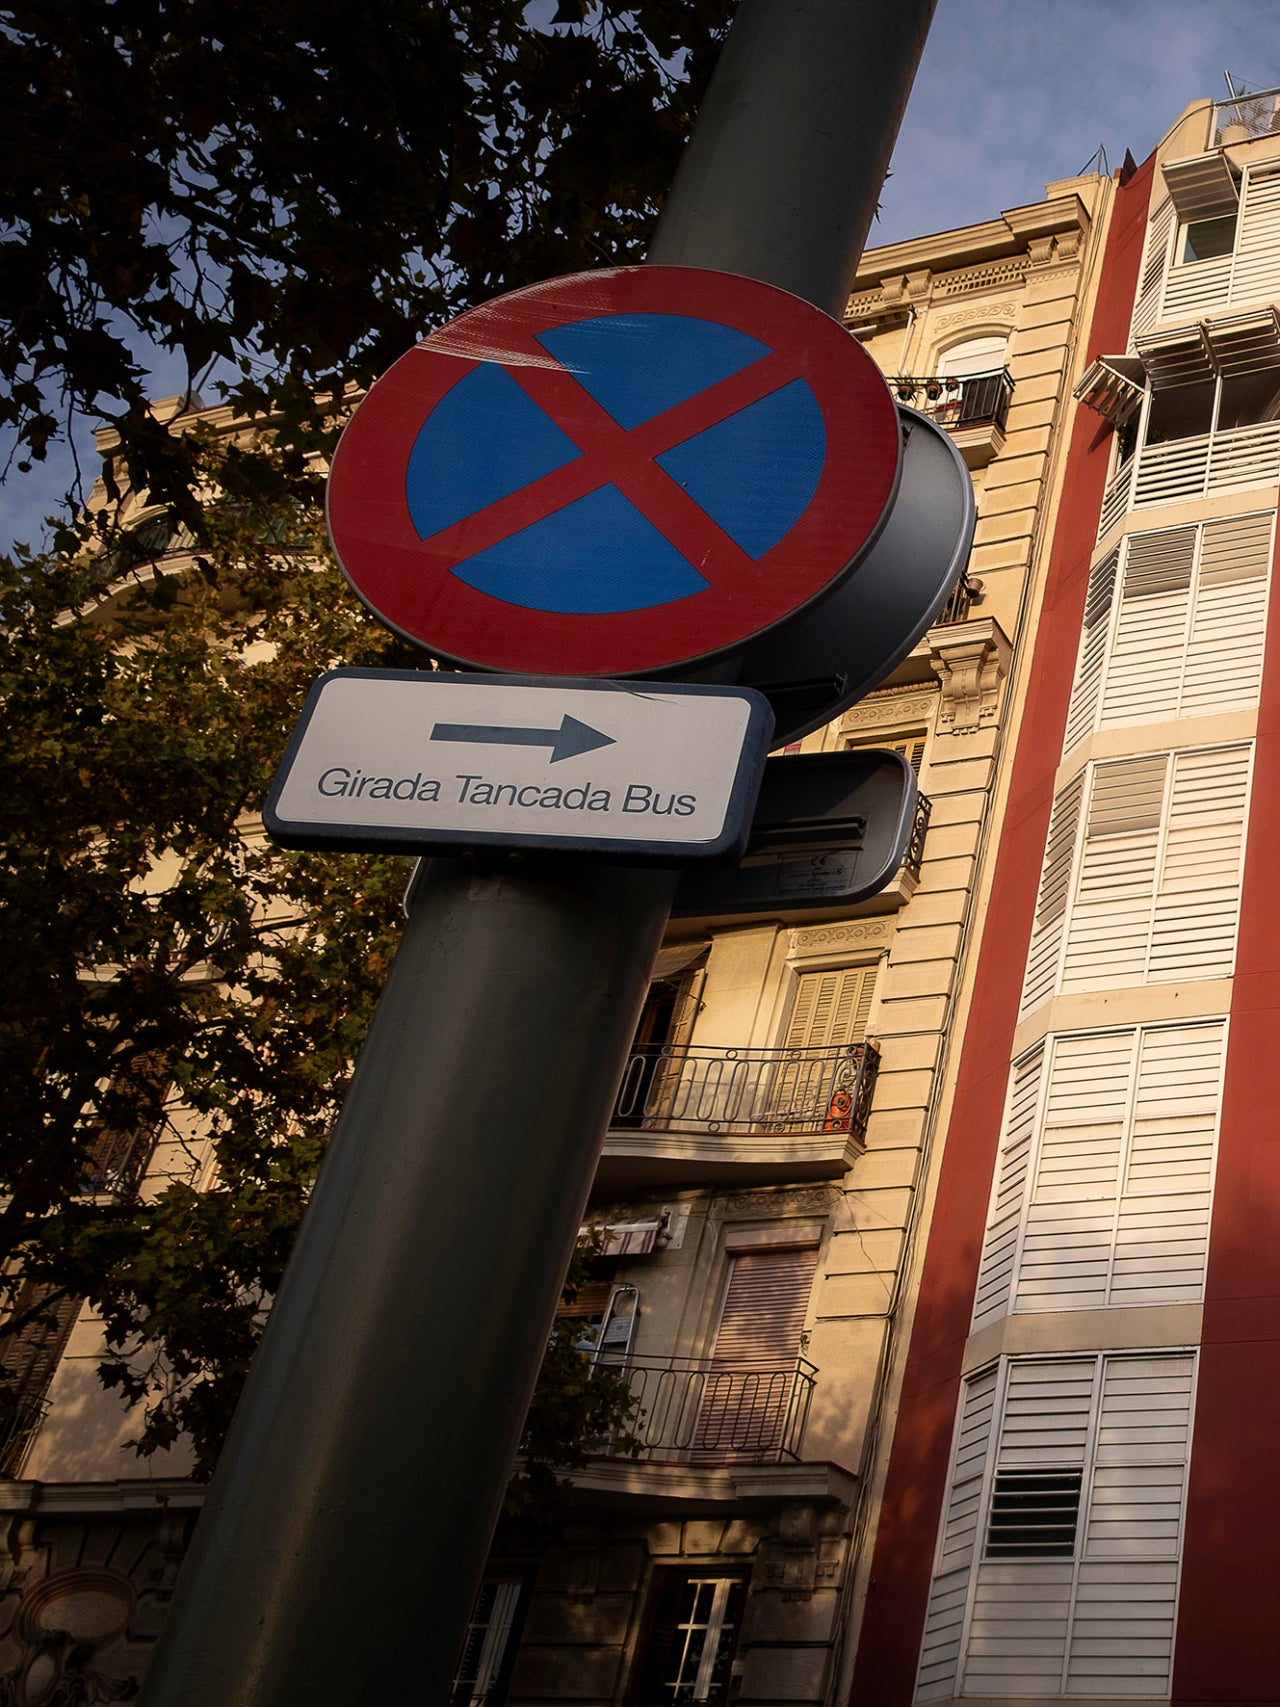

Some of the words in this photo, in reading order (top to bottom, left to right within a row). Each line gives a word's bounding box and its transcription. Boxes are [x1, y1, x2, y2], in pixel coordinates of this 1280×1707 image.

[318, 767, 440, 802] Girada
[455, 775, 611, 812] Tancada
[622, 785, 697, 817] Bus
